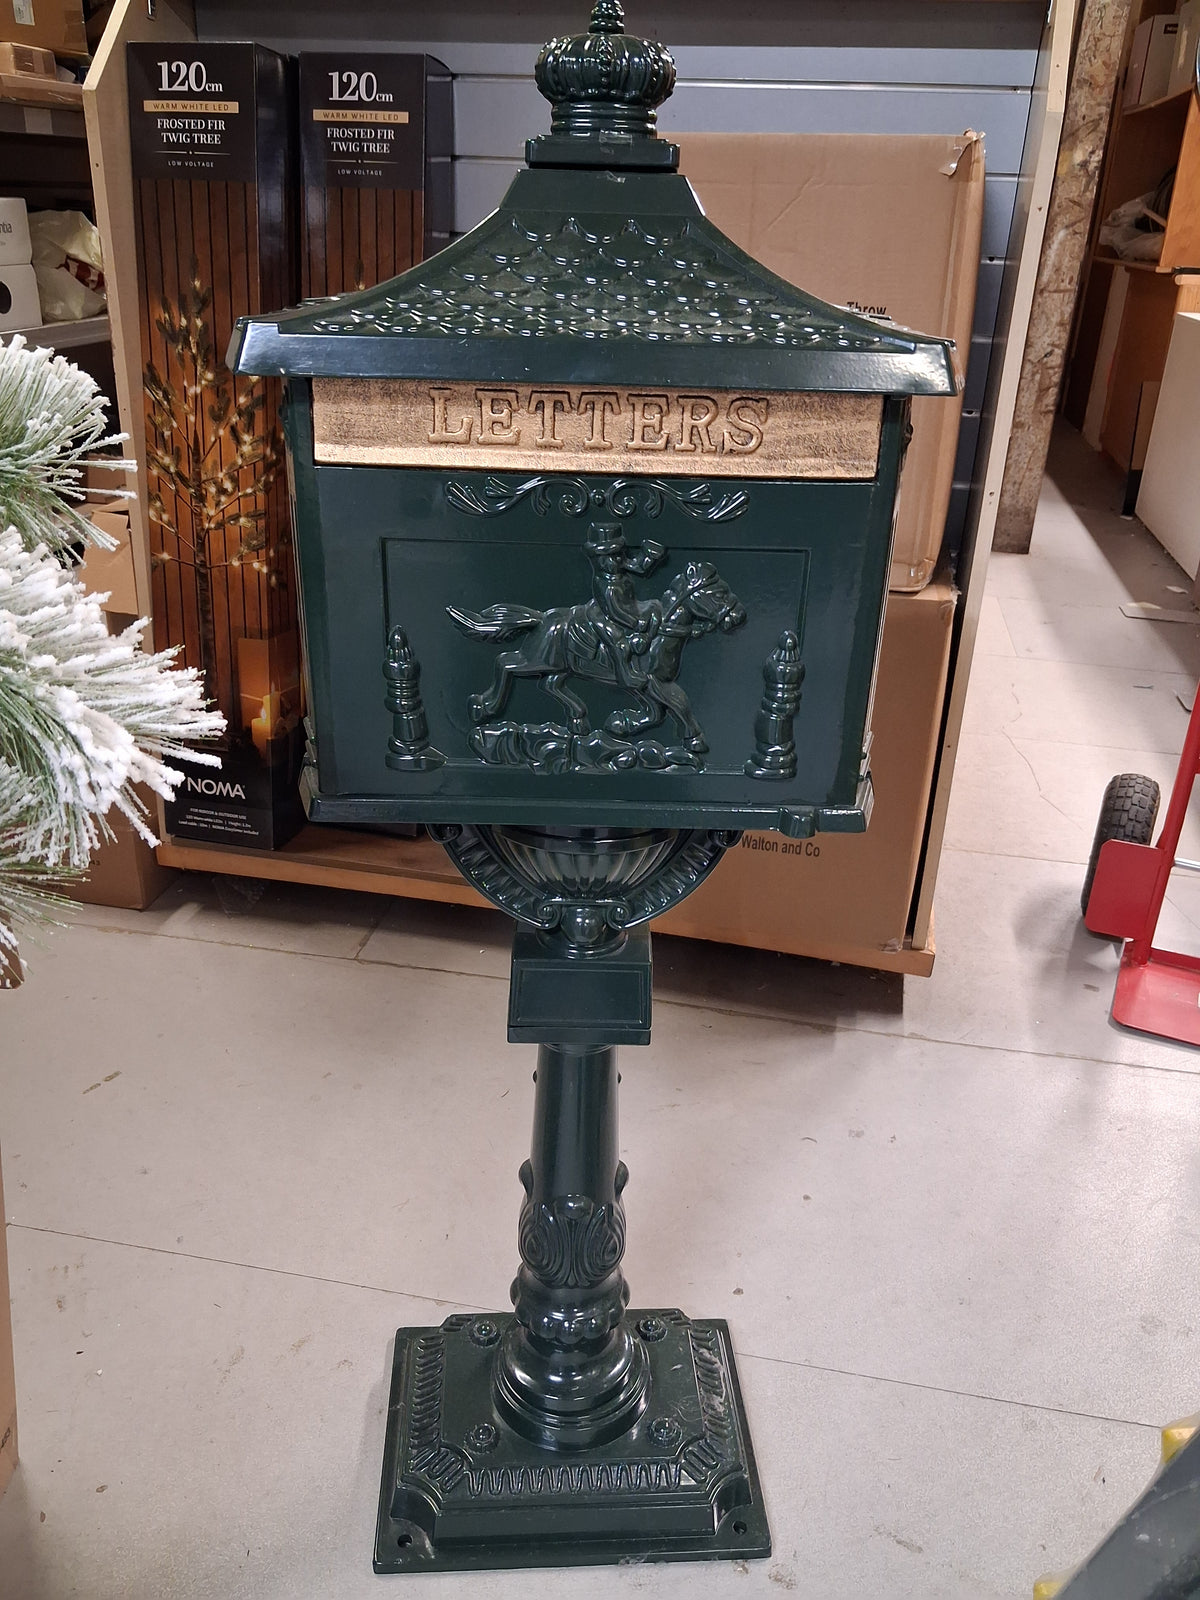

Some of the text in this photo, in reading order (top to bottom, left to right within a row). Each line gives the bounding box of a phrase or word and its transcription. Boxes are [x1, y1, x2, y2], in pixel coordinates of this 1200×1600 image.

[157, 61, 223, 92] 120cm
[328, 71, 393, 102] 120cm
[181, 103, 209, 111] WHITE
[351, 112, 379, 120] WHITE
[383, 113, 399, 121] LED
[157, 118, 226, 131] FROSTED FIR
[161, 132, 222, 145] TWIG TREE
[327, 127, 395, 140] FROSTED FIR
[331, 141, 390, 154] TWIG TREE
[846, 301, 887, 316] Throw
[427, 387, 769, 456] LETTERS
[187, 776, 246, 800] NOMA
[741, 834, 820, 857] Walton and Co
